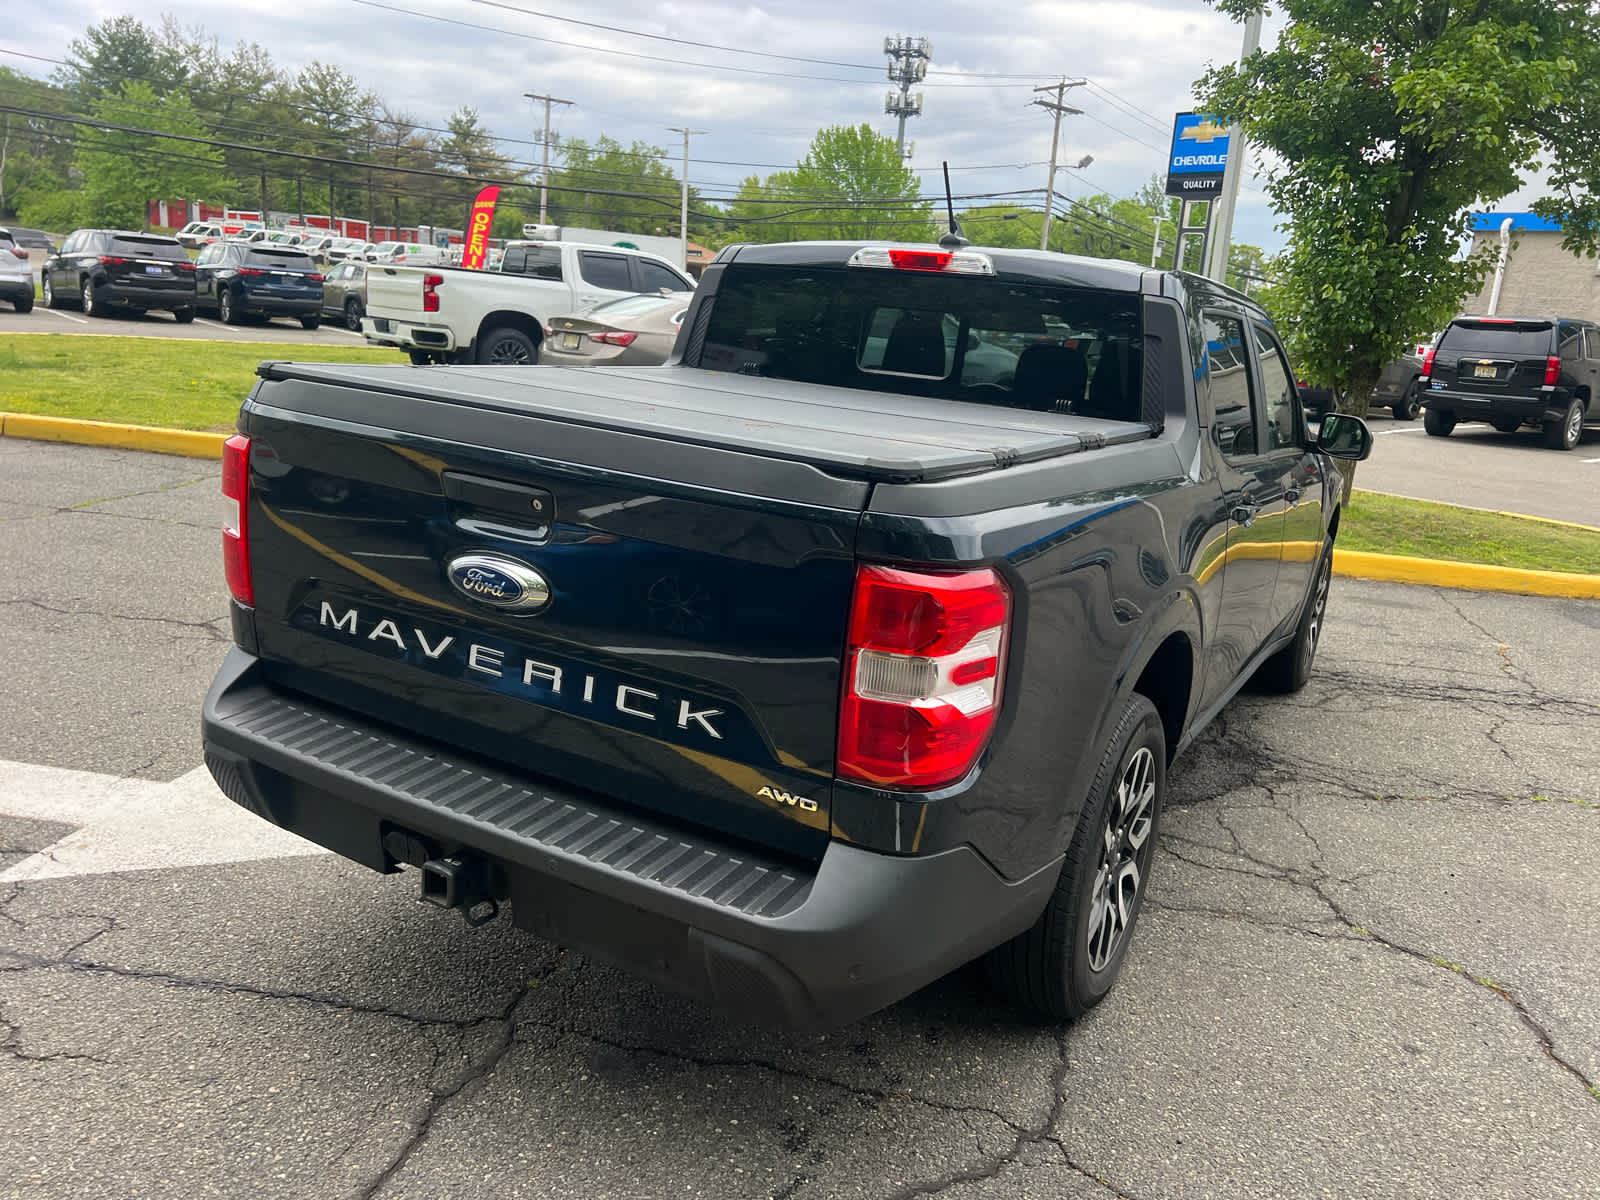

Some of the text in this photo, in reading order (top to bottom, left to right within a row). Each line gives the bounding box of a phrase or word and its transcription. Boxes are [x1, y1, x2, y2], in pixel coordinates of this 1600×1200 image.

[1173, 154, 1228, 167] CHEVROLE
[1183, 180, 1216, 189] QUALITY
[466, 212, 489, 269] OPENI
[463, 568, 505, 597] Ford
[319, 601, 723, 740] MAVERICK
[757, 786, 818, 811] AWD
